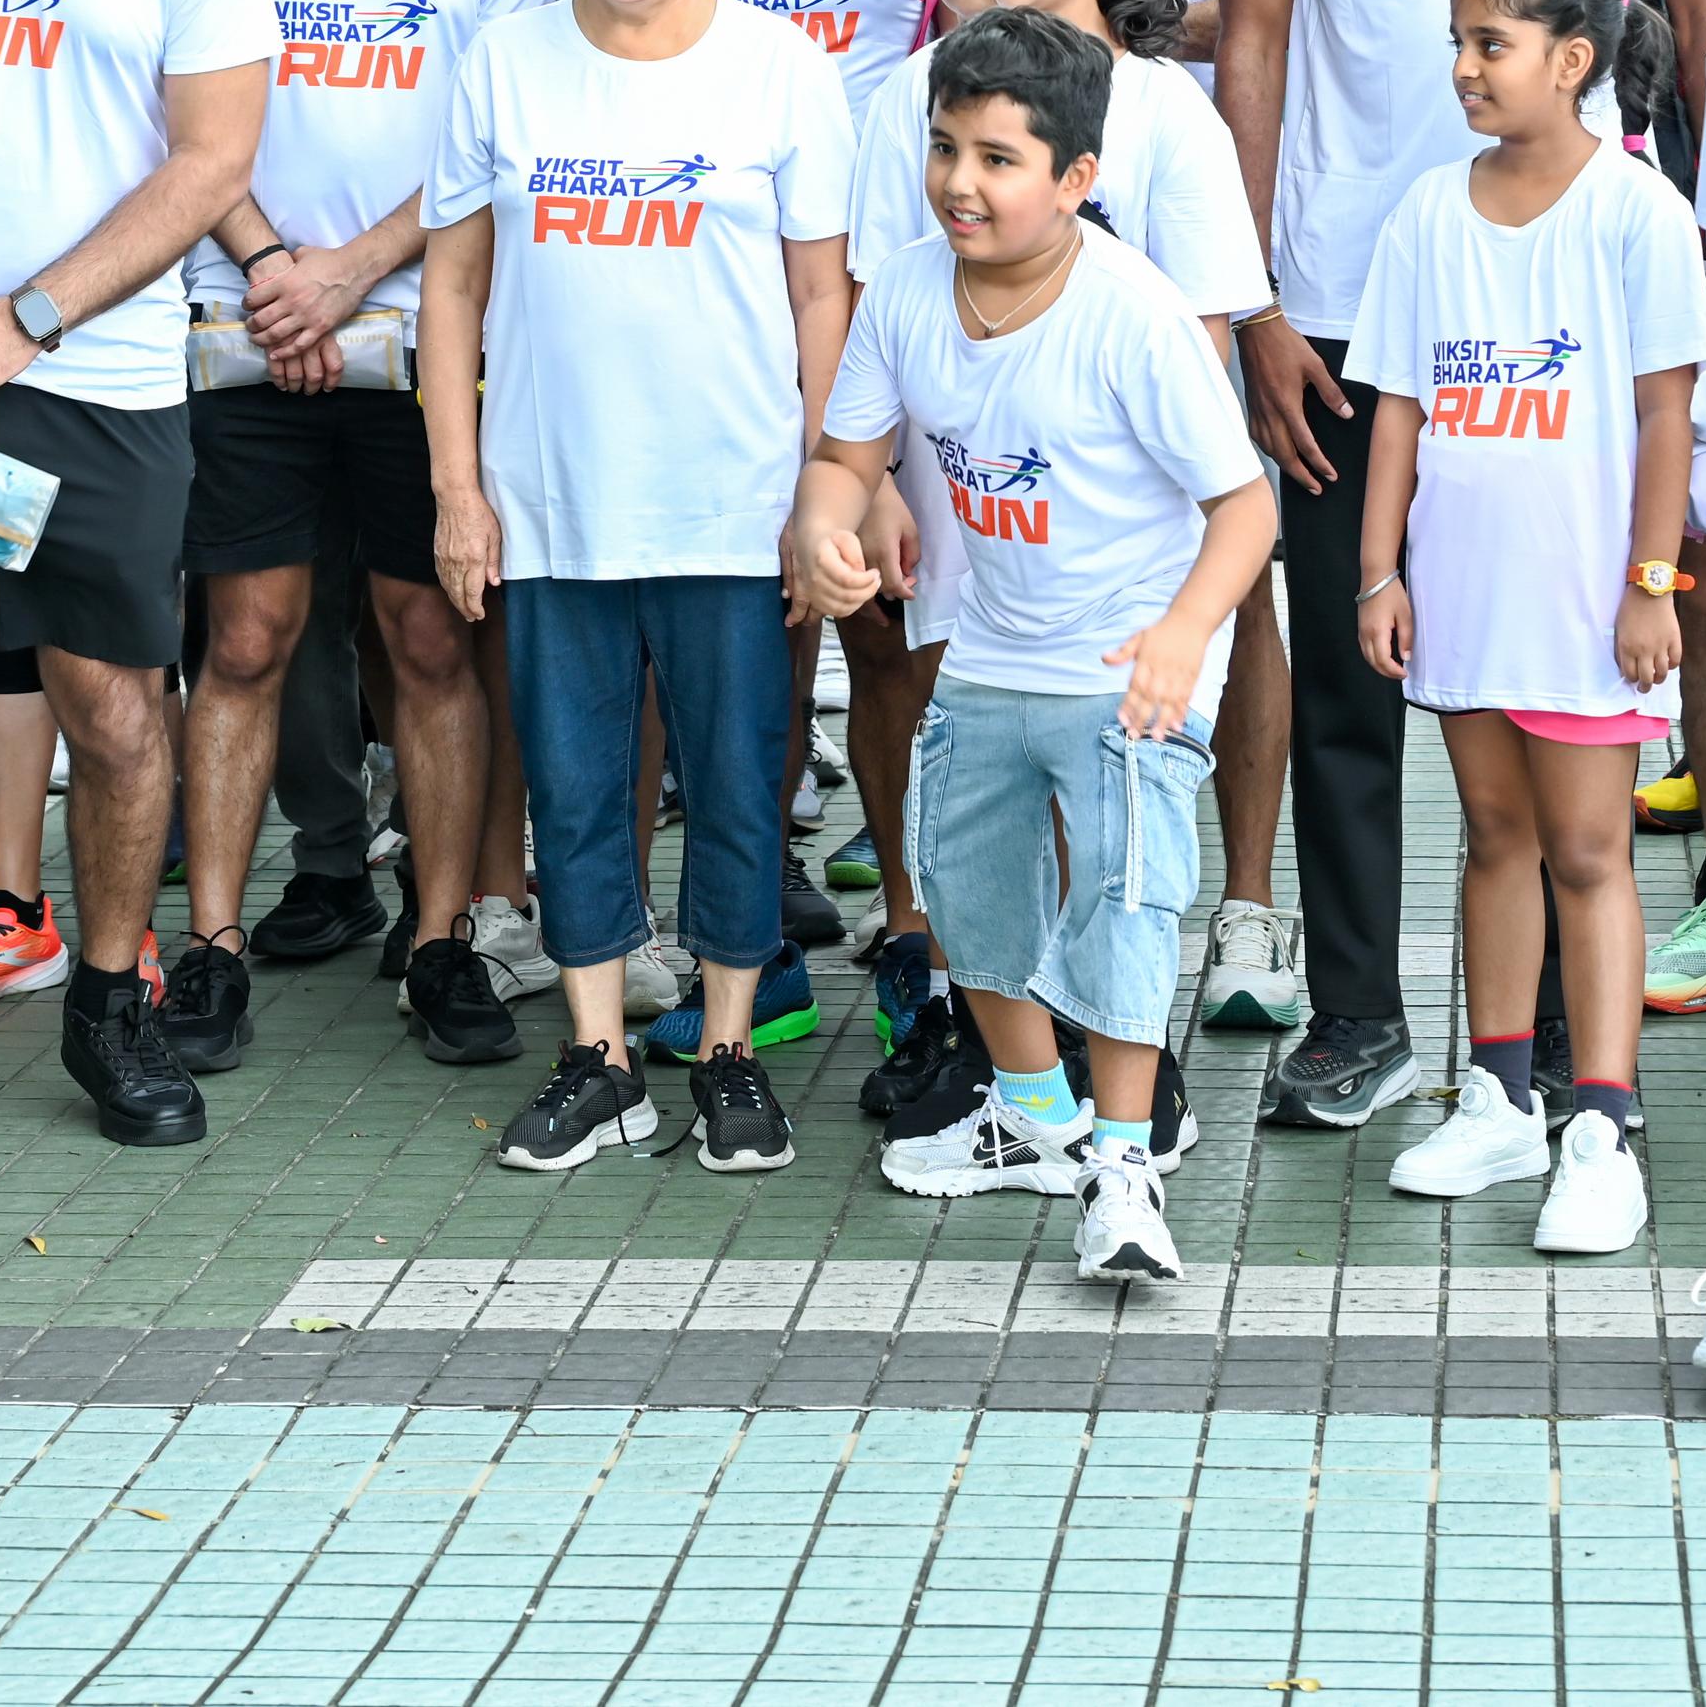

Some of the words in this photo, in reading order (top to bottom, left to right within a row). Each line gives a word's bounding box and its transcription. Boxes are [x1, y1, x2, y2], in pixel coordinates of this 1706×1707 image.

[275, 1, 355, 22] VIKSIT
[277, 42, 426, 90] RUN
[536, 157, 623, 177] VIKSIT
[527, 174, 647, 197] BHARAT
[533, 195, 704, 248] RUN
[1433, 340, 1497, 363] VIKSIT
[1433, 361, 1518, 385] BHARAT
[1430, 386, 1571, 440] RUN
[935, 445, 991, 493] ARAT
